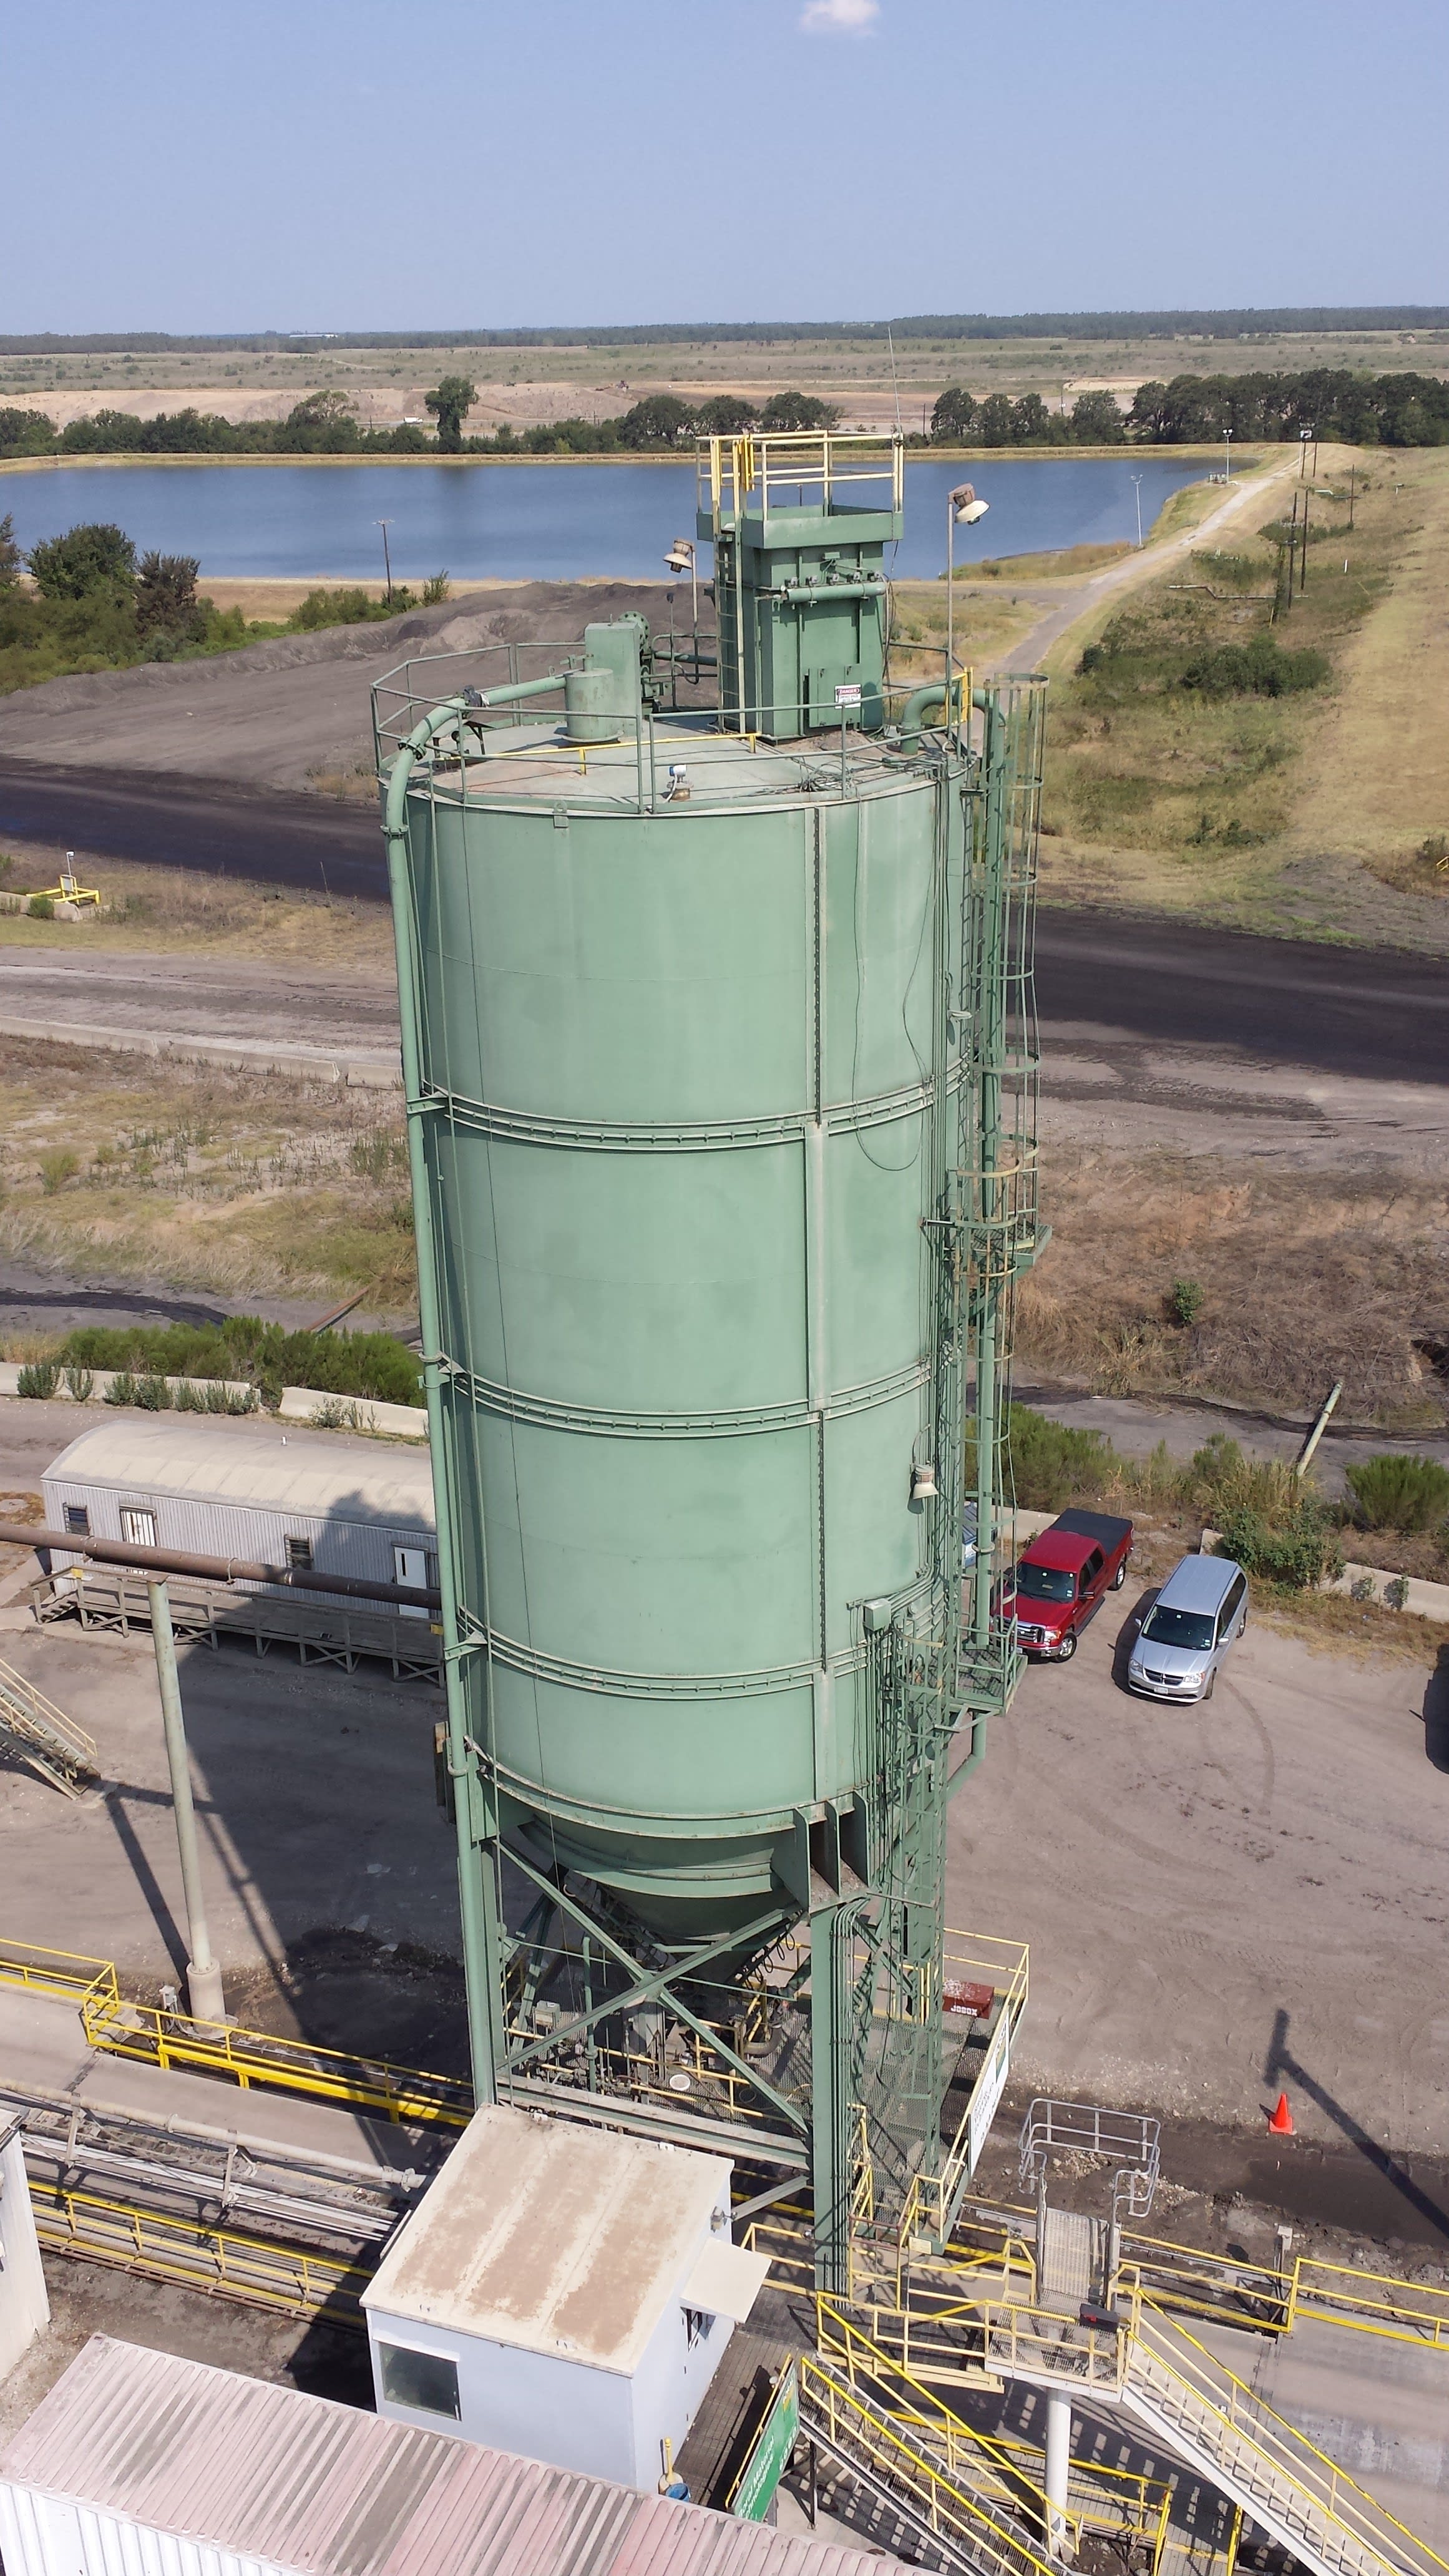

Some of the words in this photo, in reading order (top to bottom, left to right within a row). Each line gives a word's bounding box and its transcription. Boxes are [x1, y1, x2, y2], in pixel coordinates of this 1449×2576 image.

[950, 2005, 977, 2016] JOBOX
[746, 2454, 773, 2519] chnologies
[753, 2435, 774, 2489] Material
